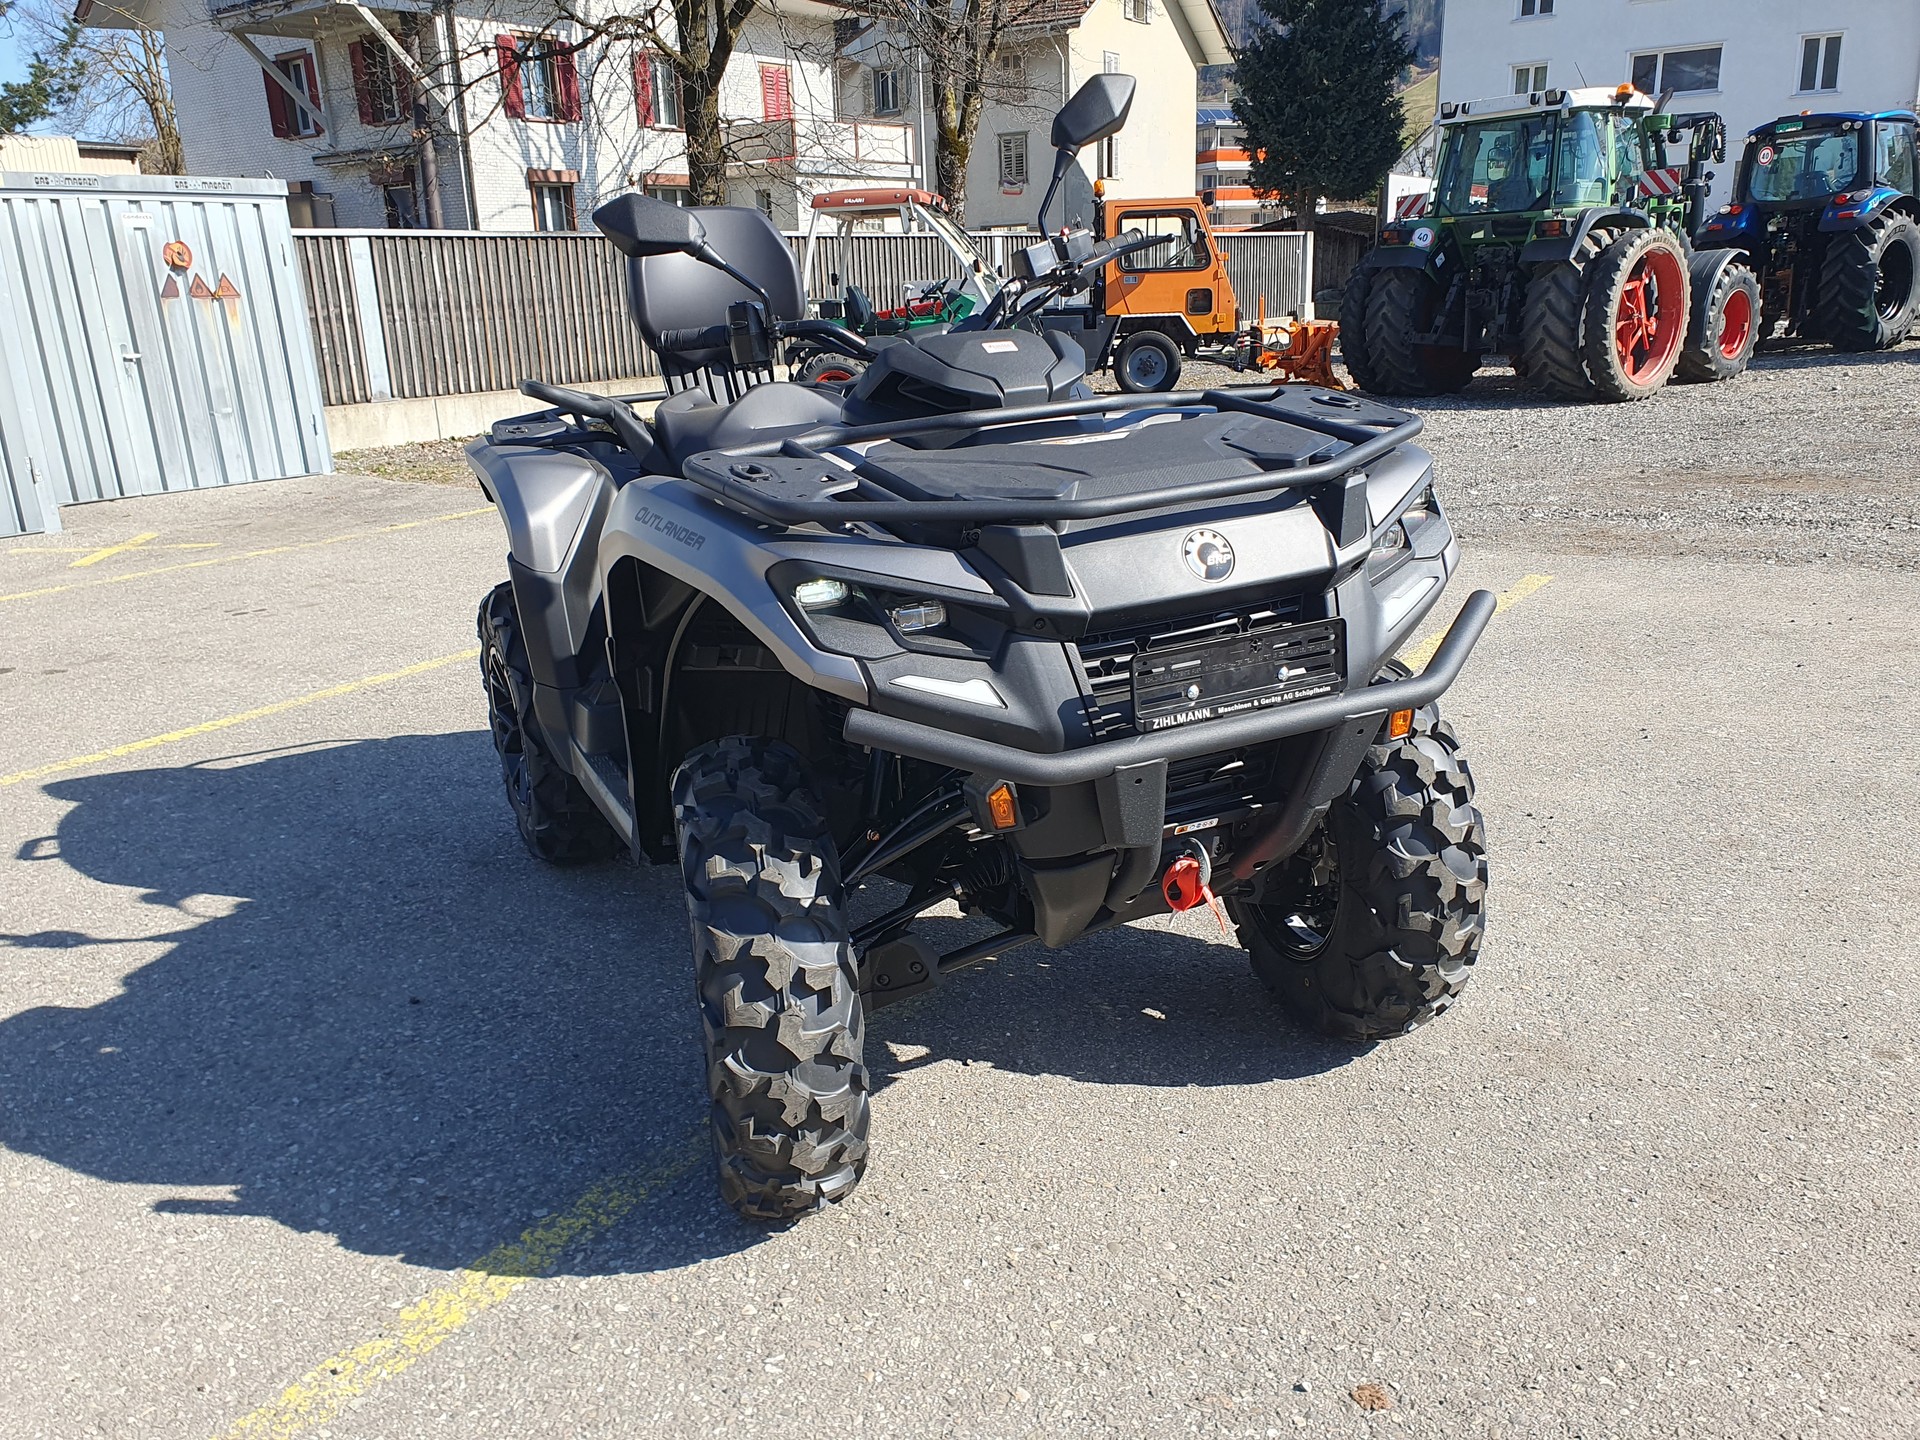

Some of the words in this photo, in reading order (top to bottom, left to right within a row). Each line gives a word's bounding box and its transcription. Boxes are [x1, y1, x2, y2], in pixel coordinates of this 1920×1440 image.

[1417, 232, 1428, 242] 40
[634, 506, 706, 551] OUTLANDER
[1207, 553, 1231, 566] BRP
[1153, 708, 1212, 729] ZIHLMANN
[1218, 702, 1252, 713] Maschinen
[1261, 695, 1281, 705] Geräte
[1283, 692, 1293, 700] AG
[1294, 685, 1331, 698] Schüpfheim
